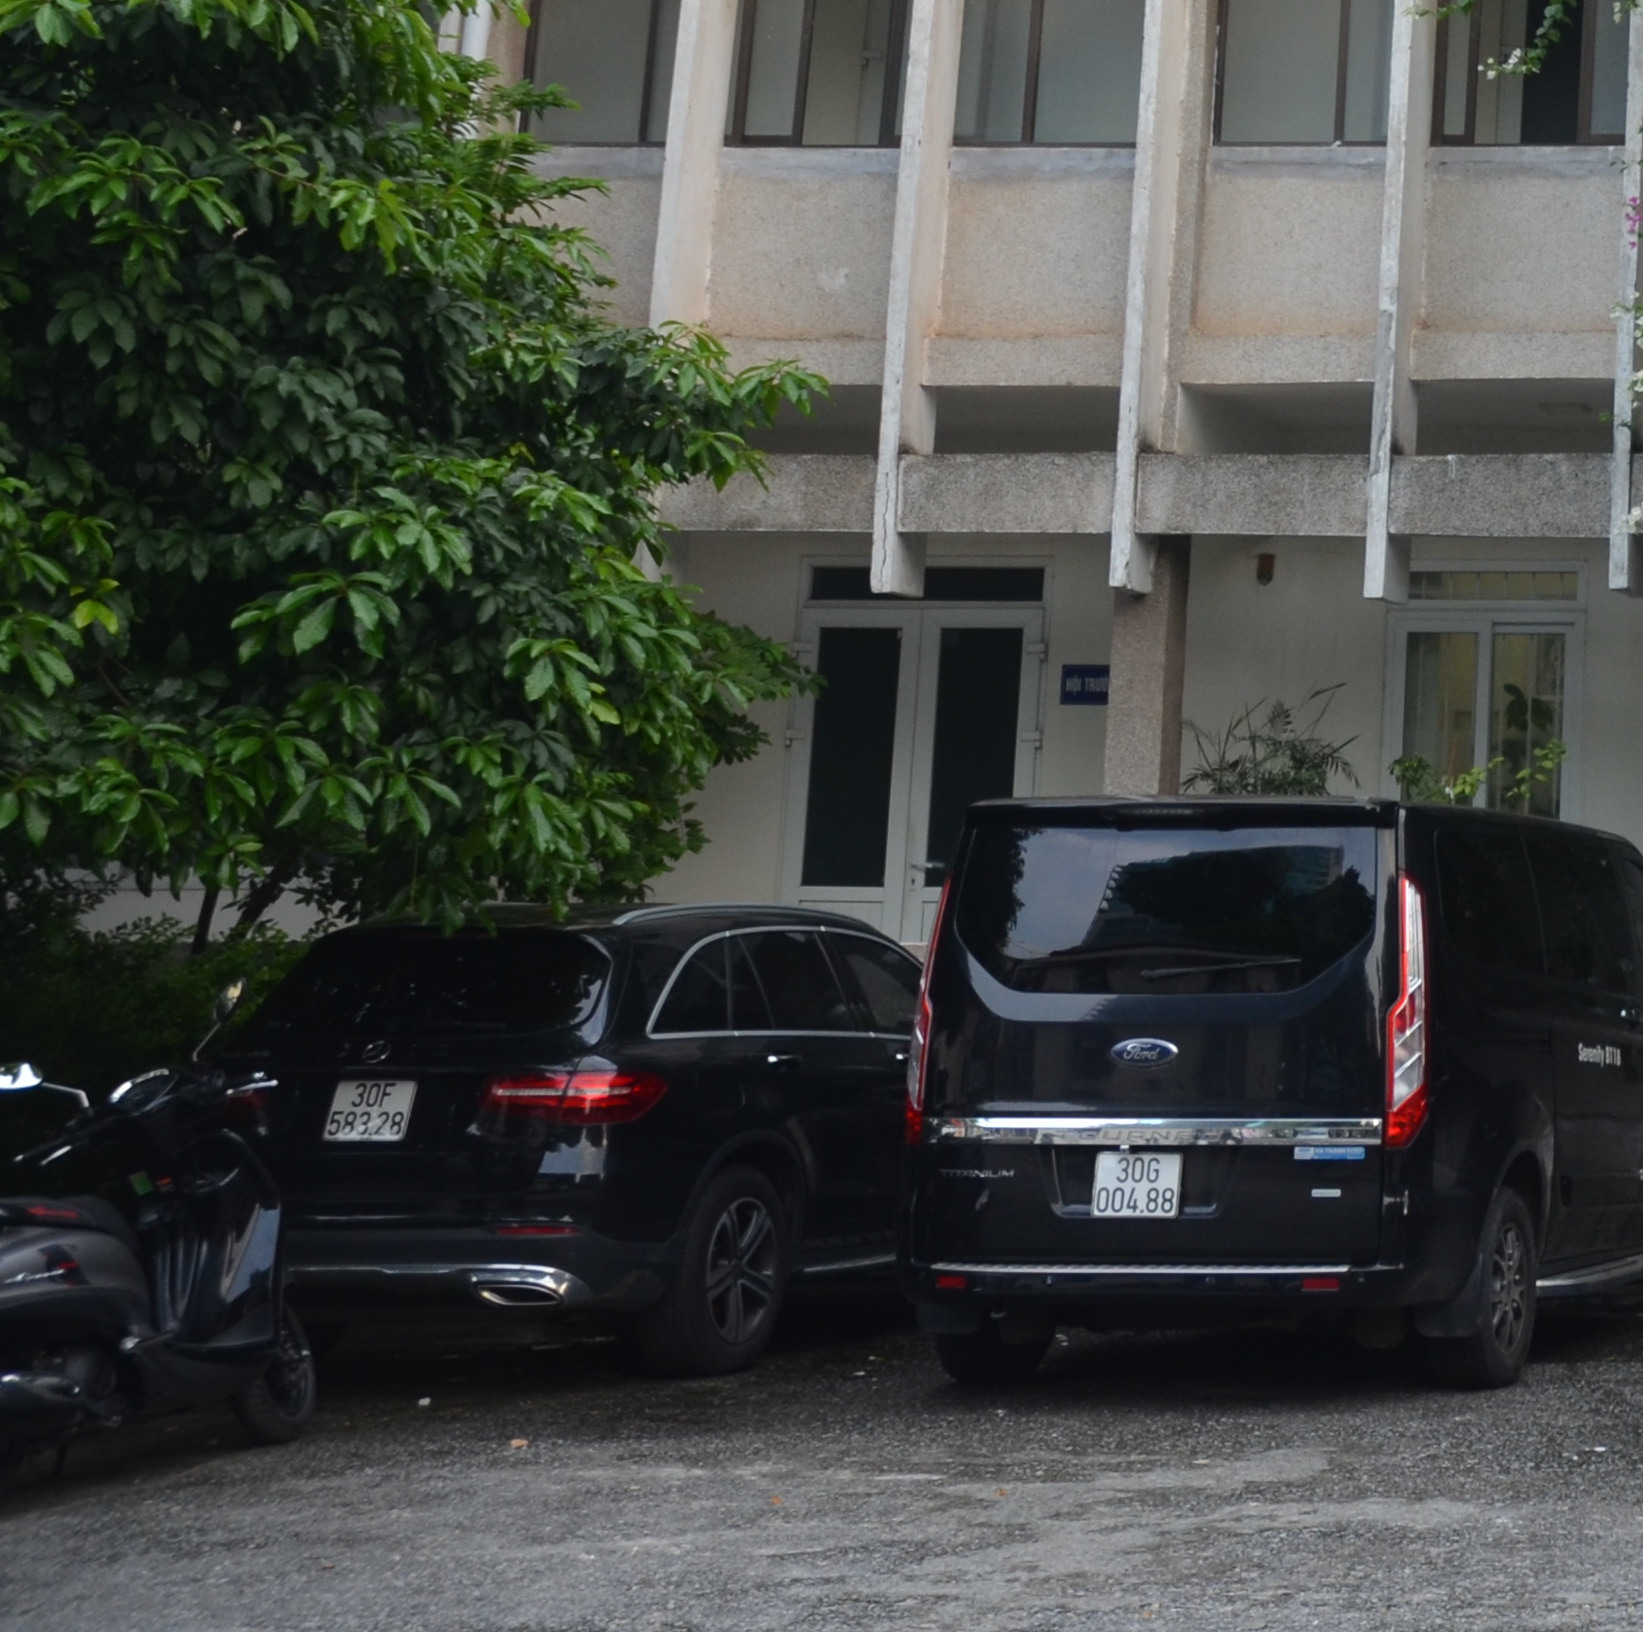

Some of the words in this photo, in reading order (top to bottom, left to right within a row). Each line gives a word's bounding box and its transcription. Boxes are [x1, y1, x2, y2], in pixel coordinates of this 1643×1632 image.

[1123, 1043, 1161, 1060] Ford
[351, 1082, 397, 1108] 30F
[328, 1110, 405, 1136] 583.28
[1116, 1157, 1160, 1183] 30G
[1096, 1186, 1175, 1214] 004.88
